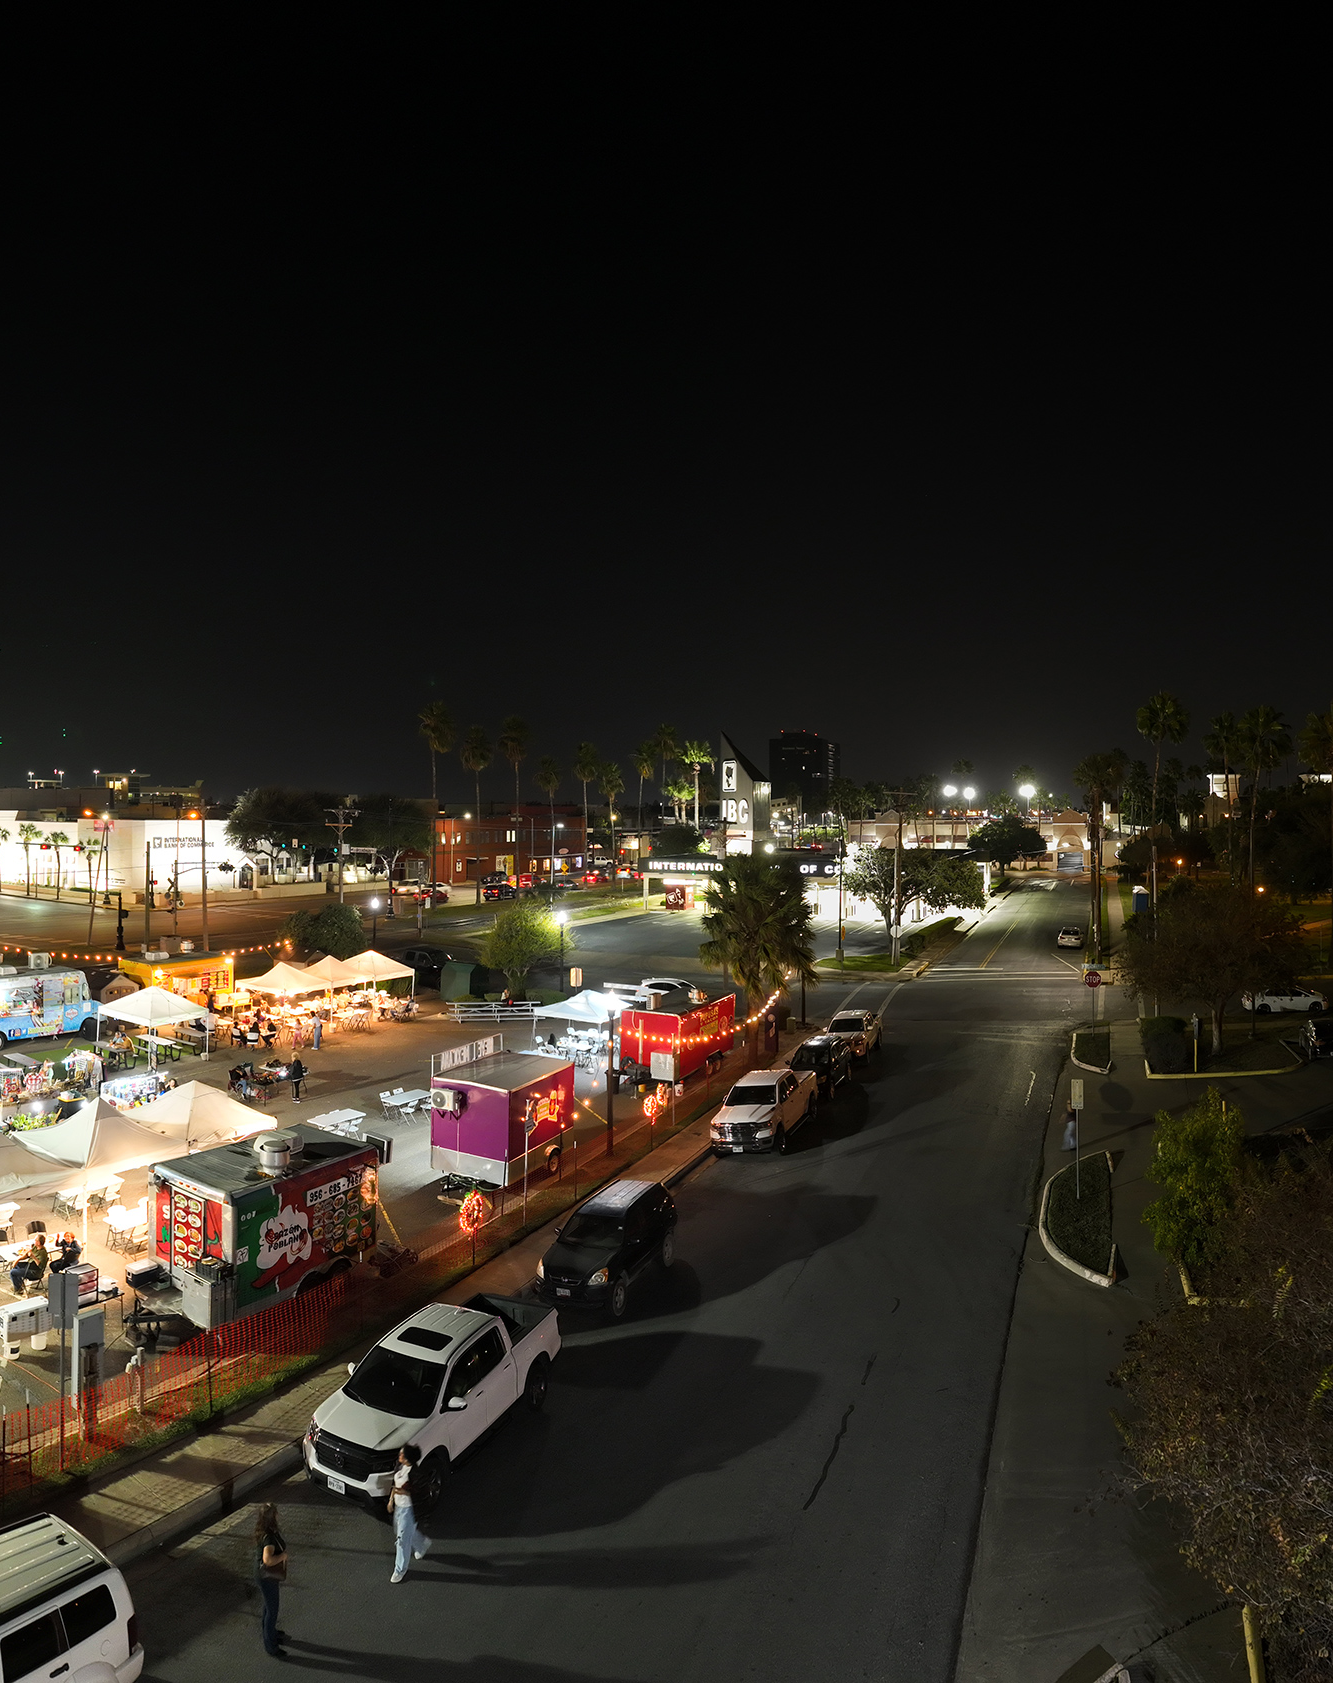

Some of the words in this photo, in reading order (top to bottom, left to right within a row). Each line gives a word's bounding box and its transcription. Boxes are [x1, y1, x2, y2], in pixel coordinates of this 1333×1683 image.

[722, 799, 749, 824] IBC
[649, 861, 724, 872] INTERNATIO
[799, 864, 817, 874] OF
